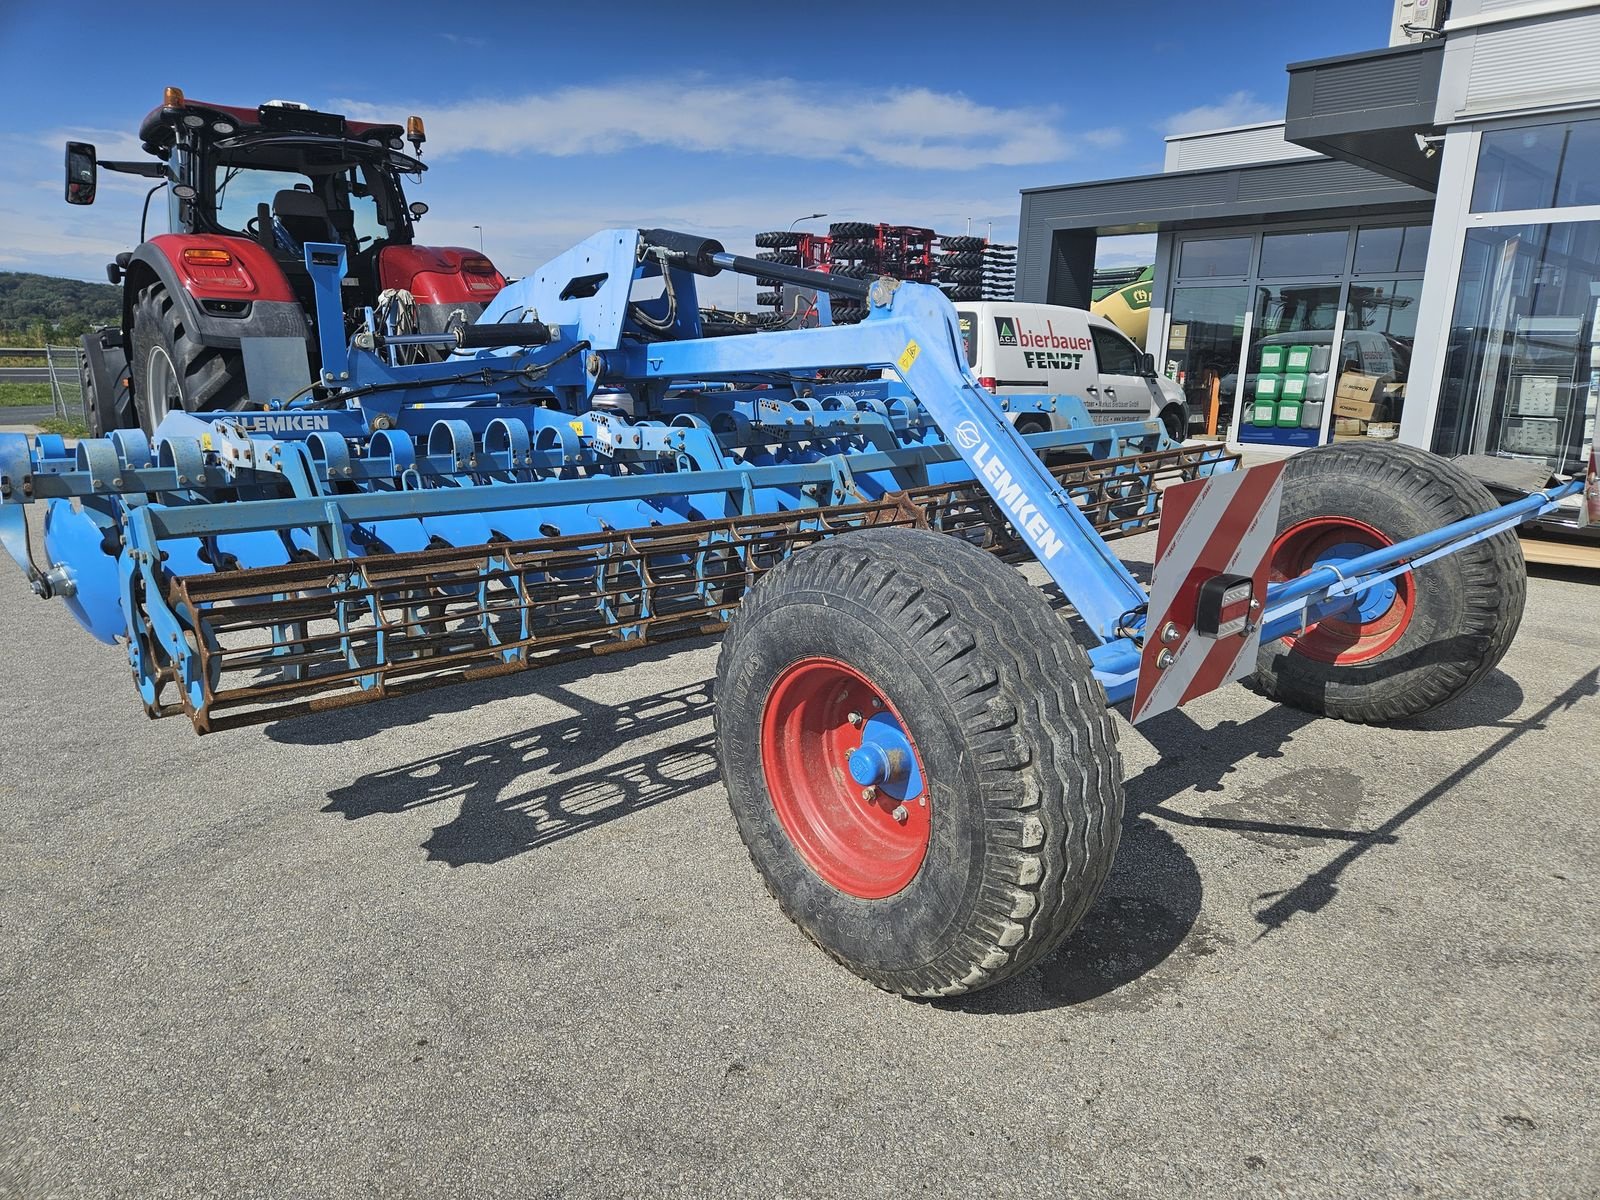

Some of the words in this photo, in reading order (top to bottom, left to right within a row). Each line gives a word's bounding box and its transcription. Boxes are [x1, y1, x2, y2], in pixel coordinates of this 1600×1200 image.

[999, 336, 1017, 344] ACA
[1015, 317, 1093, 351] bierbauer
[1024, 350, 1084, 371] FENDT
[242, 415, 329, 435] LEMKEN
[973, 442, 1064, 560] LEMKEN
